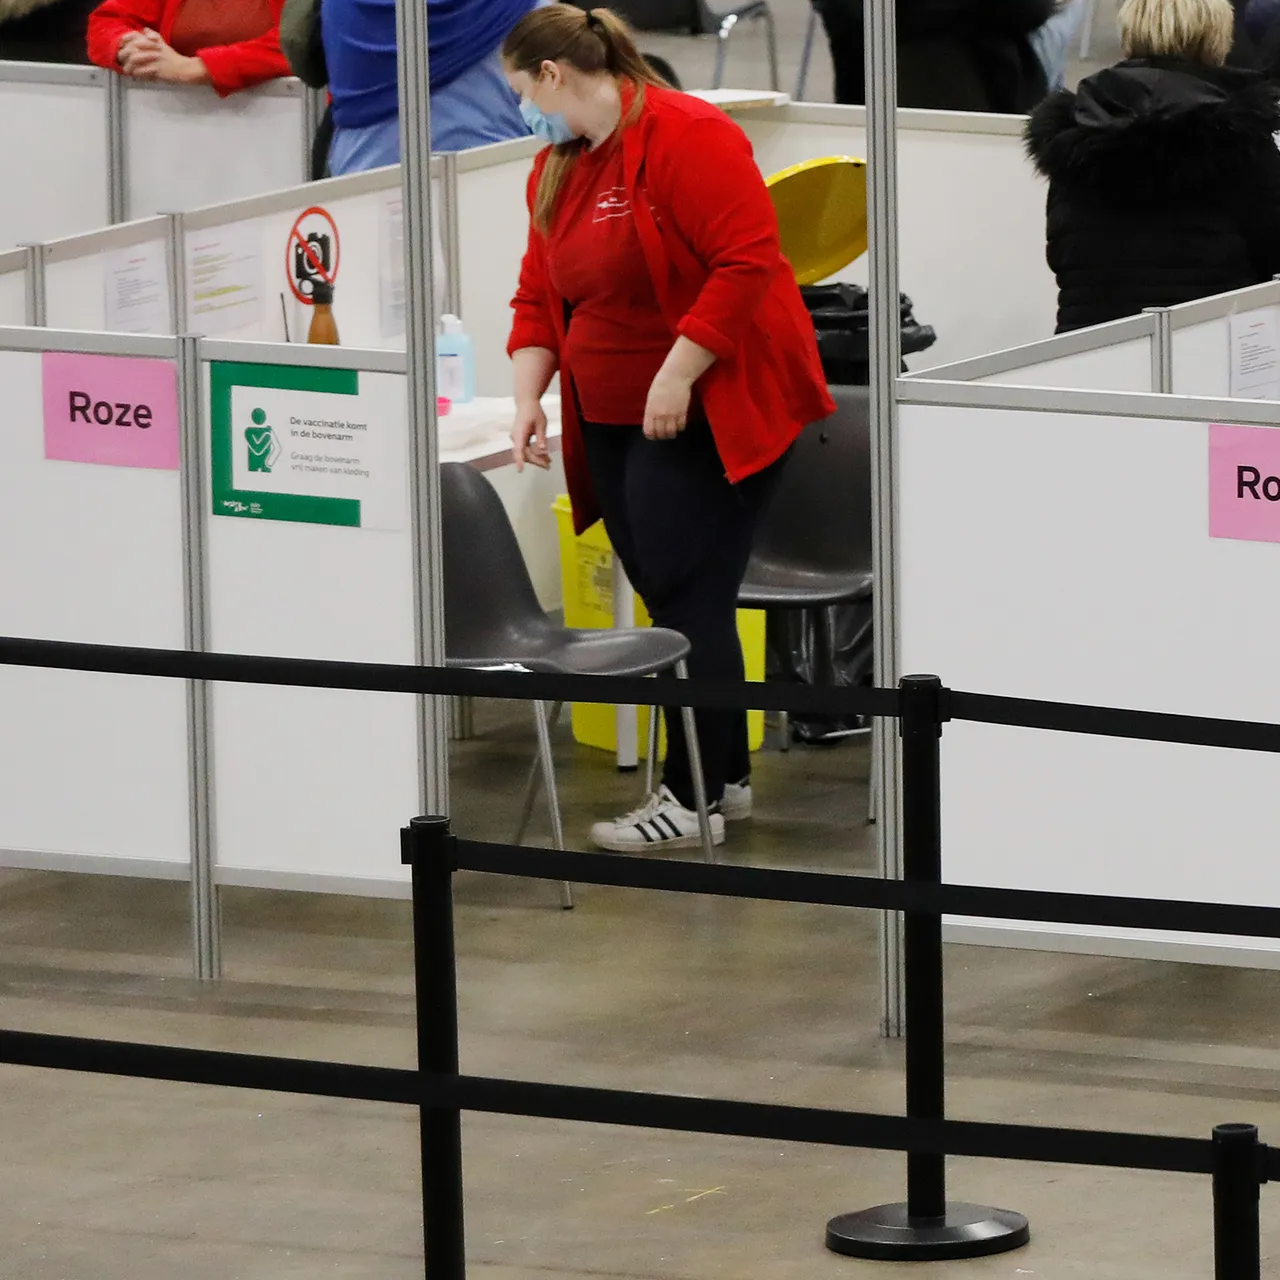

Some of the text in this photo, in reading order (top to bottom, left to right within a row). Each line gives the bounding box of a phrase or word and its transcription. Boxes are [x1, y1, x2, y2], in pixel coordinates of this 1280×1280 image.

[68, 390, 153, 430] Roze
[290, 416, 368, 430] De vaccinatie komt
[291, 428, 353, 441] in de bovenarm
